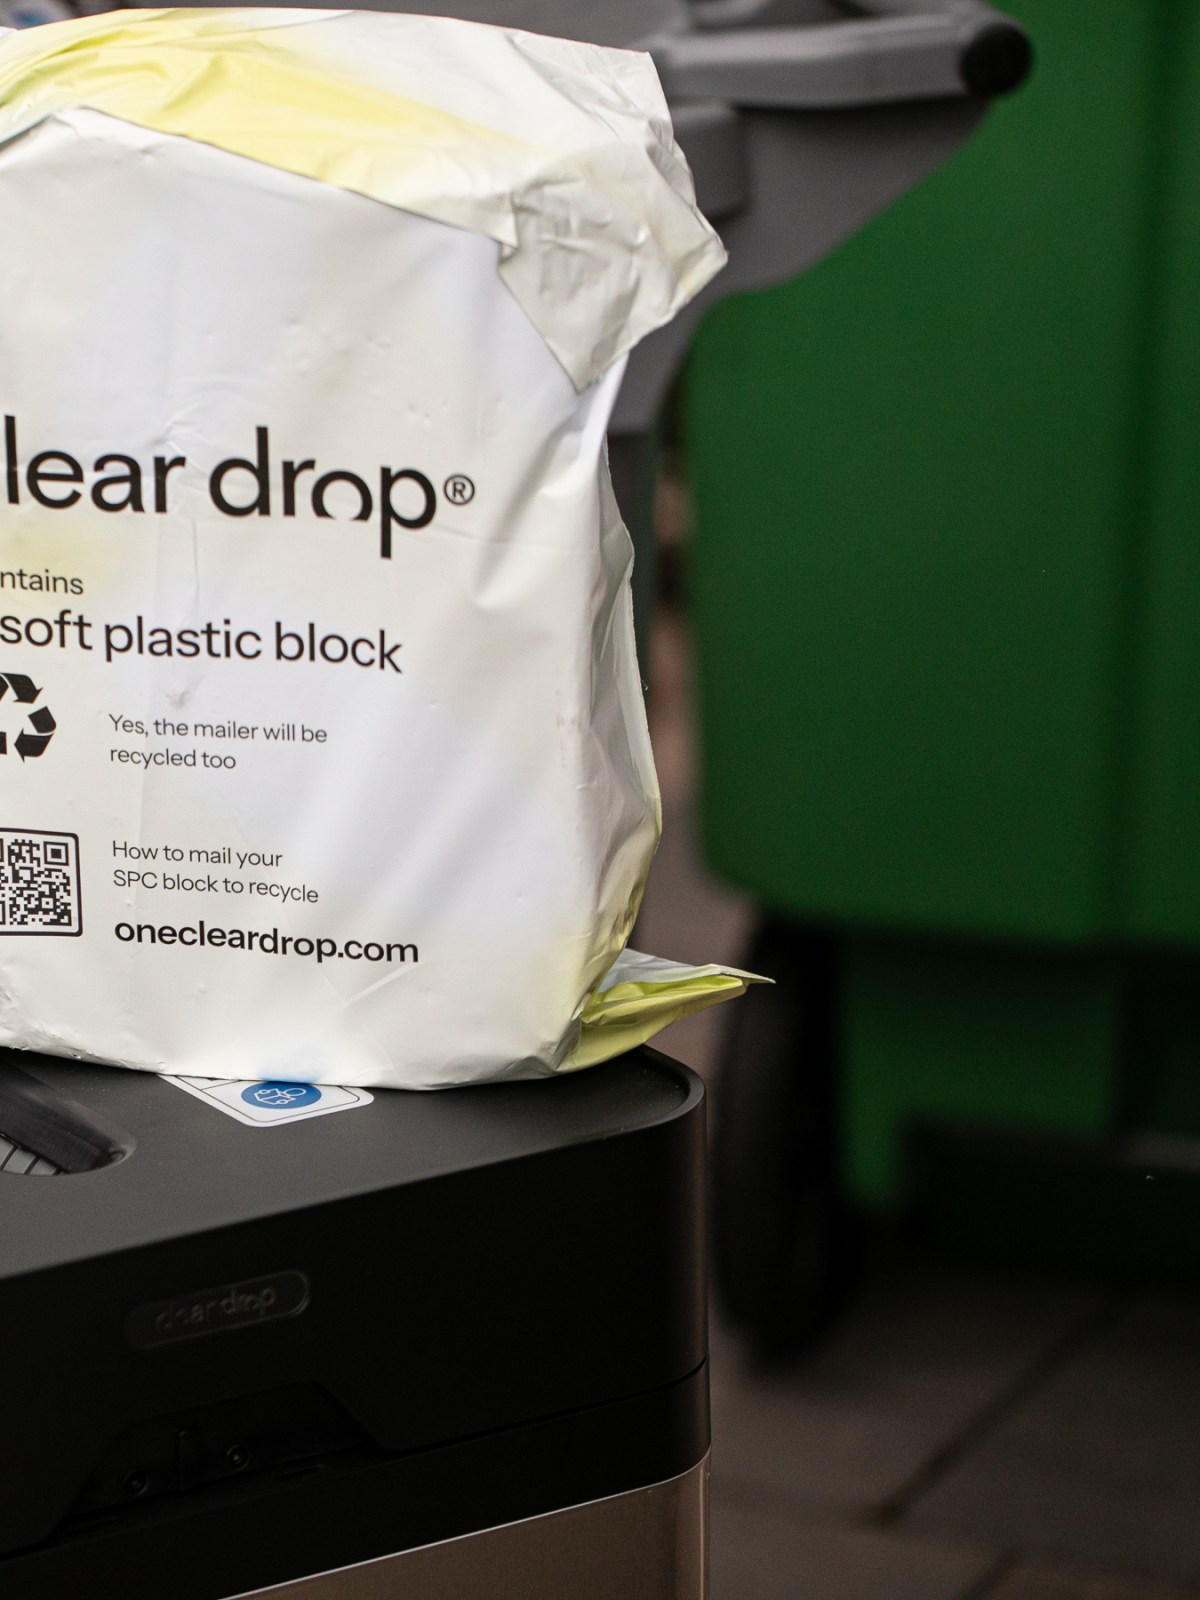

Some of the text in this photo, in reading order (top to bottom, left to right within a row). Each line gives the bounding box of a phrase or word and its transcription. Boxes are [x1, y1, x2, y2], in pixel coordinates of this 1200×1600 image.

[104, 615, 263, 663] plastic
[274, 620, 404, 675] block
[108, 713, 328, 744] Yes, the mailer will be
[110, 748, 237, 770] recycled too
[112, 839, 284, 871] How to mail your
[113, 869, 319, 904] SPC block to recycle
[114, 919, 419, 964] onecleardrop.com
